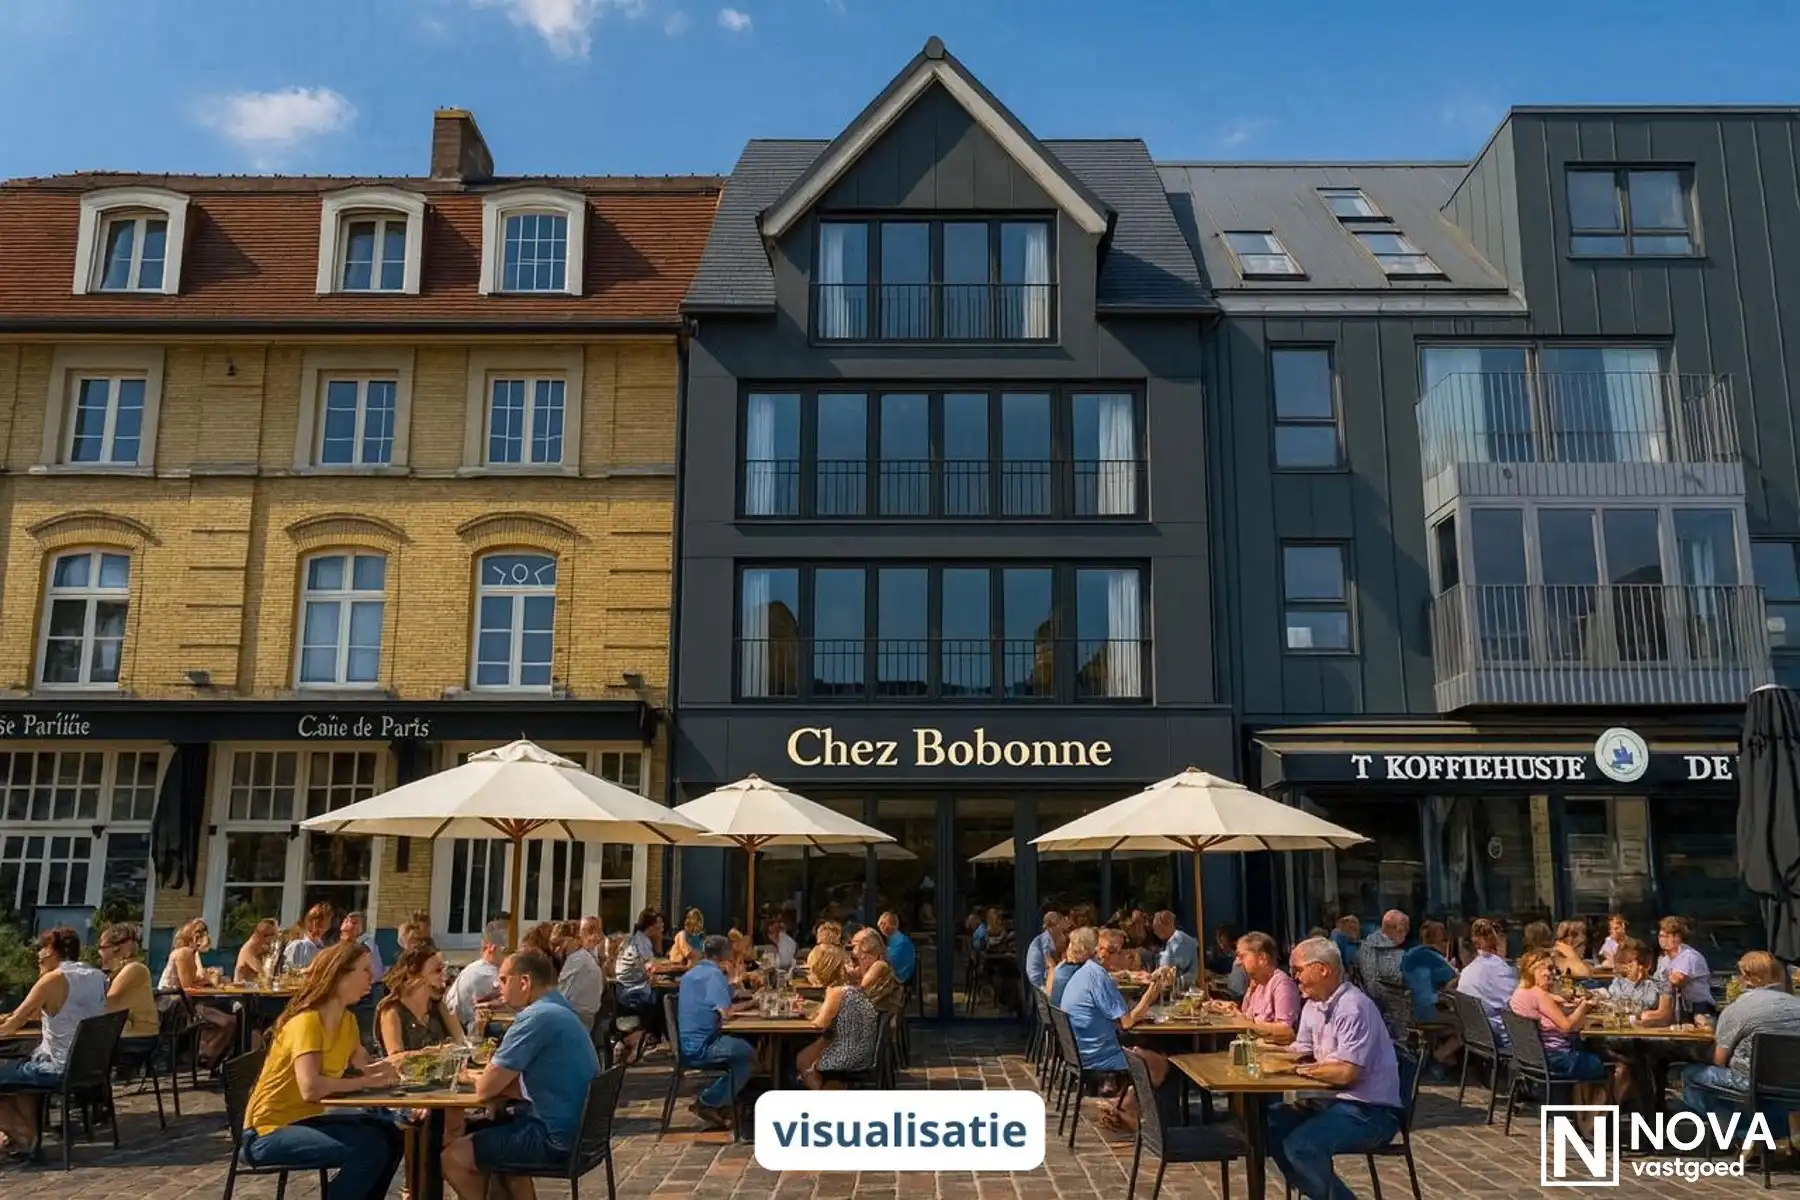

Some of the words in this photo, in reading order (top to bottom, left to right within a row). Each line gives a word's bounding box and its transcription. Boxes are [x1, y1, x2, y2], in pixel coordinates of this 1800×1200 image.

[353, 716, 372, 736] de
[381, 716, 430, 737] Paris
[787, 727, 898, 767] Chez
[912, 728, 1113, 767] Bobonne
[1684, 755, 1733, 780] DE
